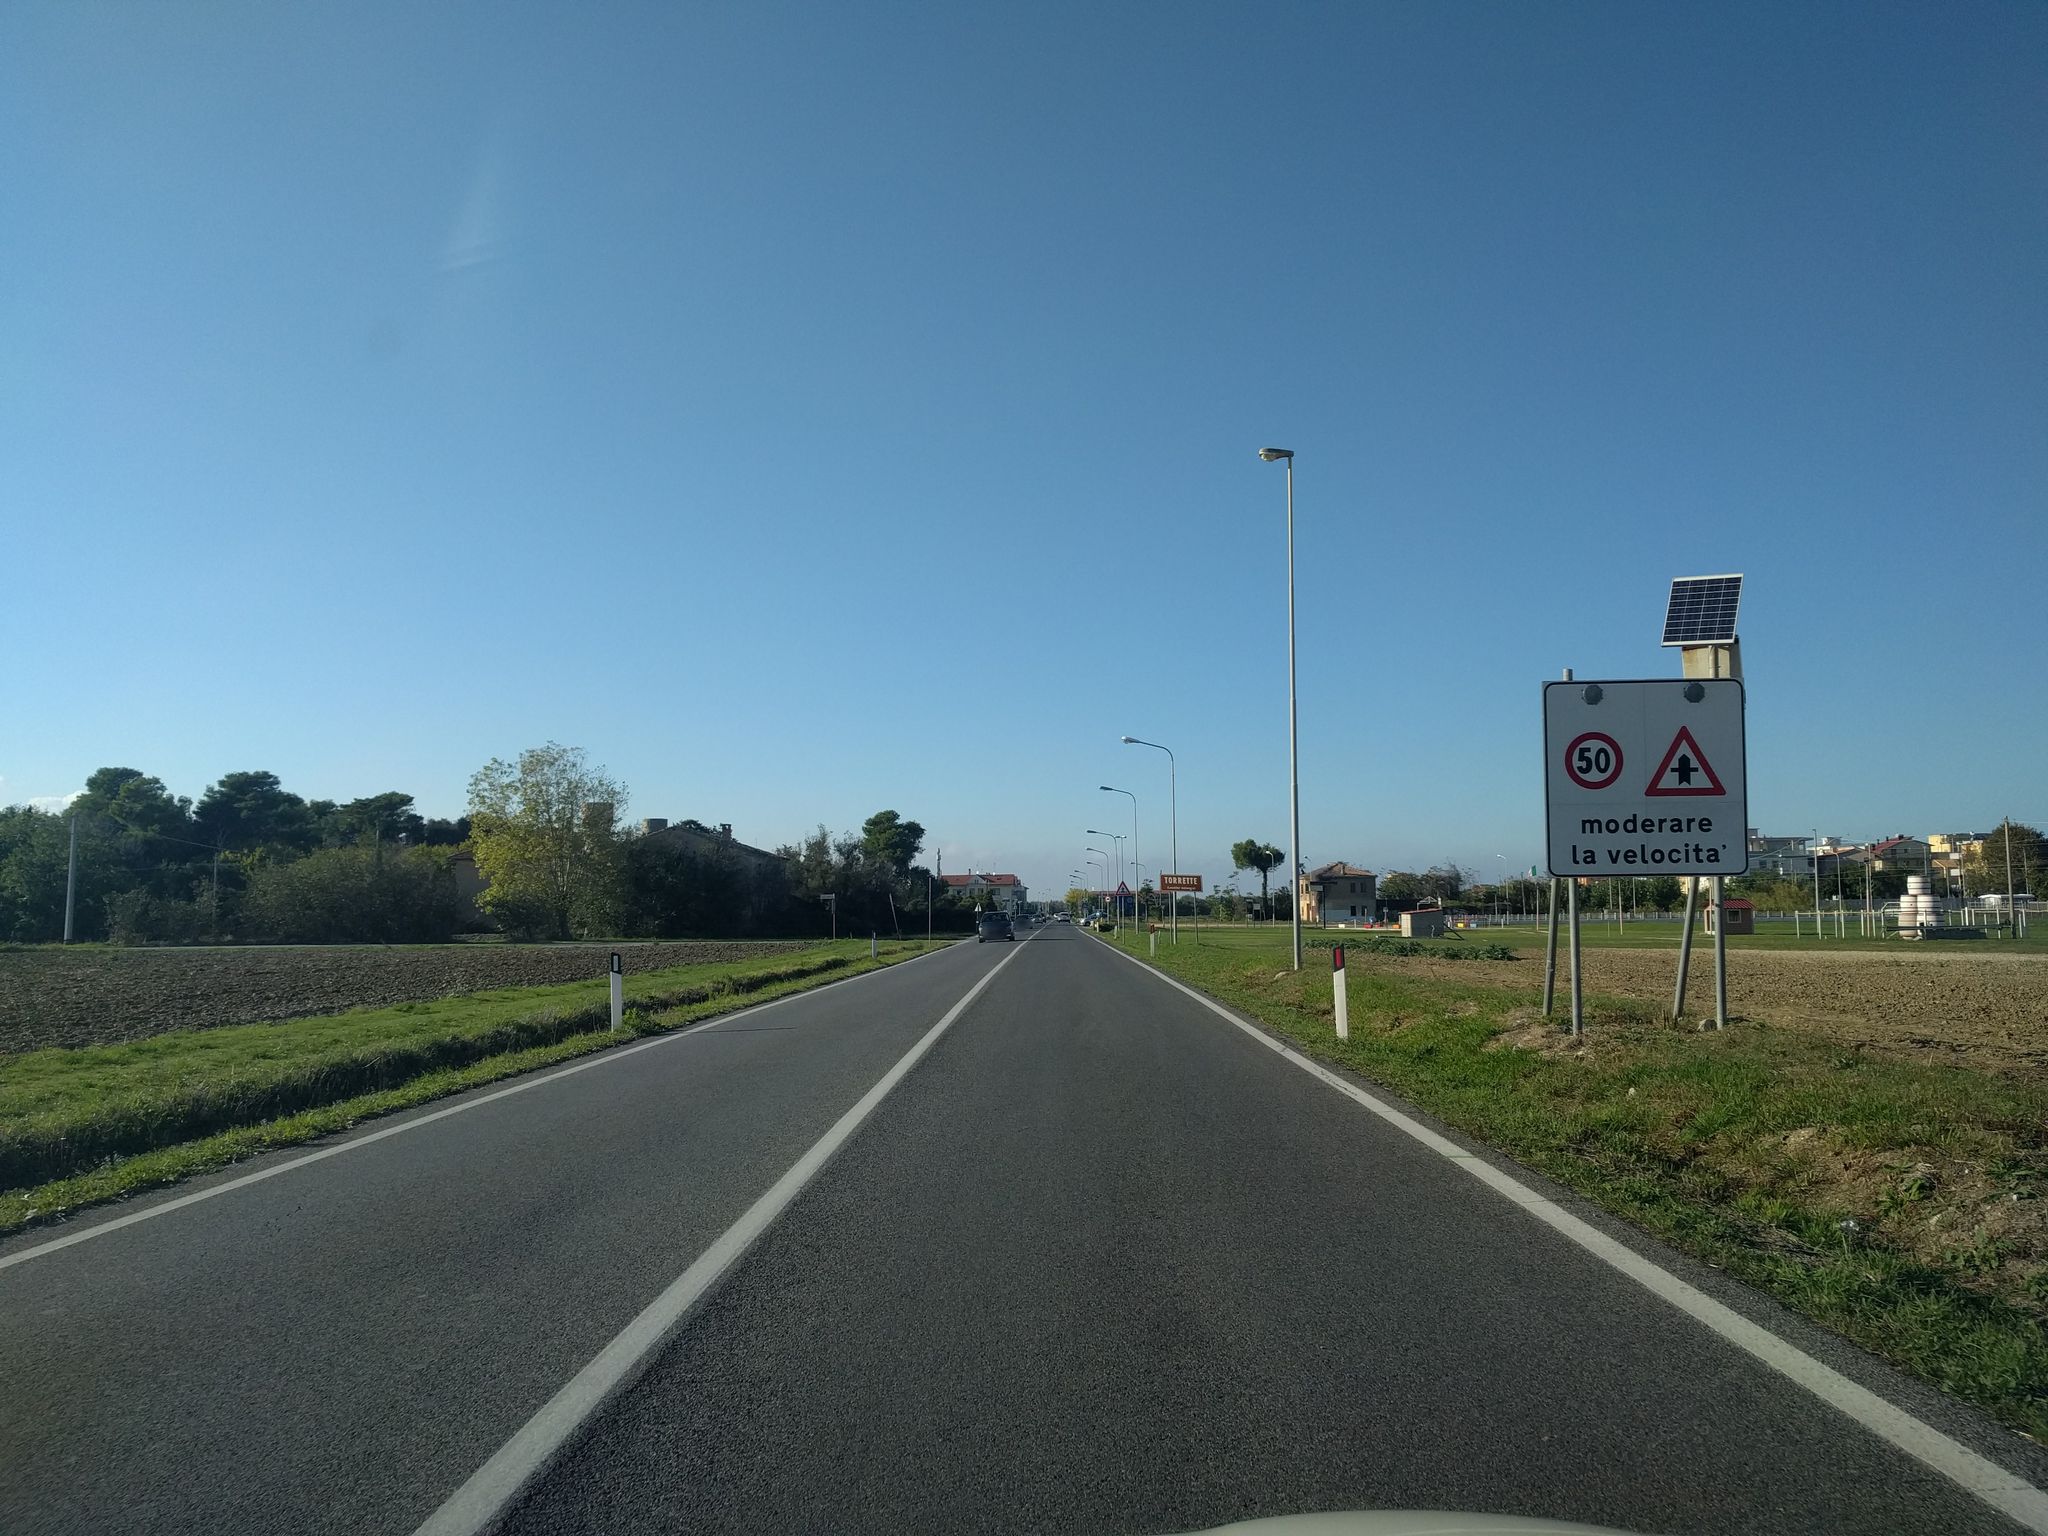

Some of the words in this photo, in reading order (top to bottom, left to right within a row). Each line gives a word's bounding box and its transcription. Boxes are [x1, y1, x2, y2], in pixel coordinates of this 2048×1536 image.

[1576, 747, 1611, 775] 50
[1581, 813, 1713, 834] moderare
[1571, 844, 1597, 865] la
[1607, 842, 1727, 865] velocita'
[1164, 876, 1198, 885] TORRETTE
